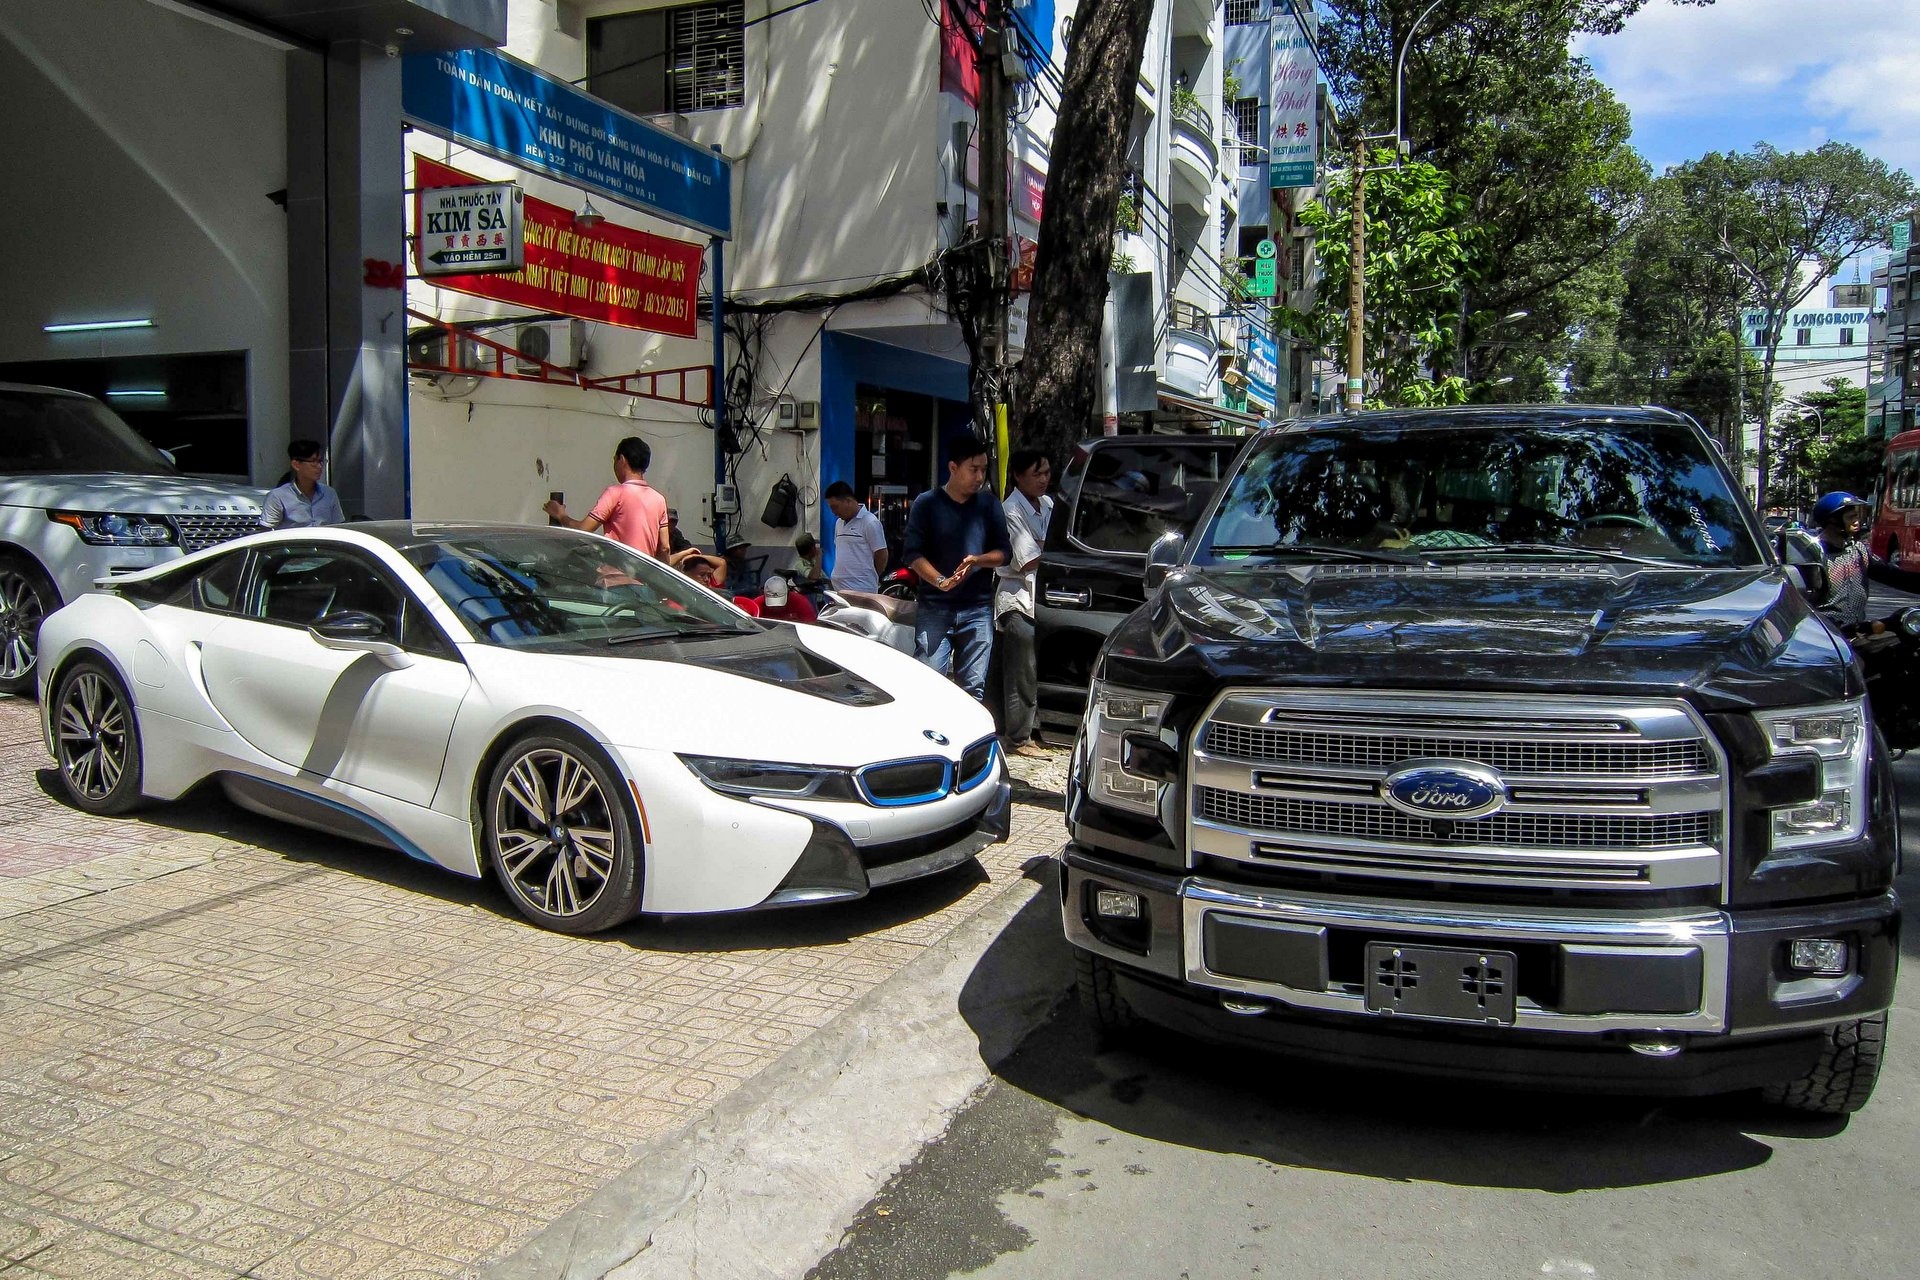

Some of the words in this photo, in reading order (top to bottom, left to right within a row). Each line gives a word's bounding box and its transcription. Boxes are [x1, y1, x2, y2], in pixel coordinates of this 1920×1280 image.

[436, 58, 466, 82] TOÀN
[469, 73, 491, 92] DÂN
[494, 84, 521, 104] ĐOÀN
[524, 97, 543, 113] KẾT
[545, 107, 563, 122] XÂY
[566, 115, 590, 135] DỰNG
[608, 132, 629, 151] SỐNG
[687, 166, 701, 182] DÂN
[525, 142, 547, 159] HẺM
[548, 153, 566, 167] 322
[587, 167, 604, 182] DÂN
[539, 125, 566, 150] KHU
[569, 137, 594, 161] PHỐ
[597, 149, 620, 173] VĂN
[623, 160, 646, 183] HÓA
[1273, 145, 1312, 155] RESTAURANT
[440, 194, 457, 209] NHÀ
[458, 191, 485, 208] THUỐC
[486, 190, 502, 205] TÂY
[427, 210, 471, 234] KIM
[478, 207, 507, 230] SA
[443, 252, 461, 263] VÀO
[462, 250, 482, 262] HẺM
[483, 251, 501, 261] 25m
[524, 214, 542, 247] ỪNG
[543, 219, 557, 250] KỶ
[556, 227, 580, 259] NIỆM
[580, 237, 592, 259] 85
[591, 237, 611, 265] NĂM
[610, 242, 632, 271] NGÀY
[632, 248, 657, 277] THÀNH
[656, 253, 671, 283] LẬP
[526, 257, 549, 289] NHẤT
[550, 265, 570, 298] VIỆT
[570, 274, 589, 299] NAM
[1411, 780, 1474, 807] Ford
